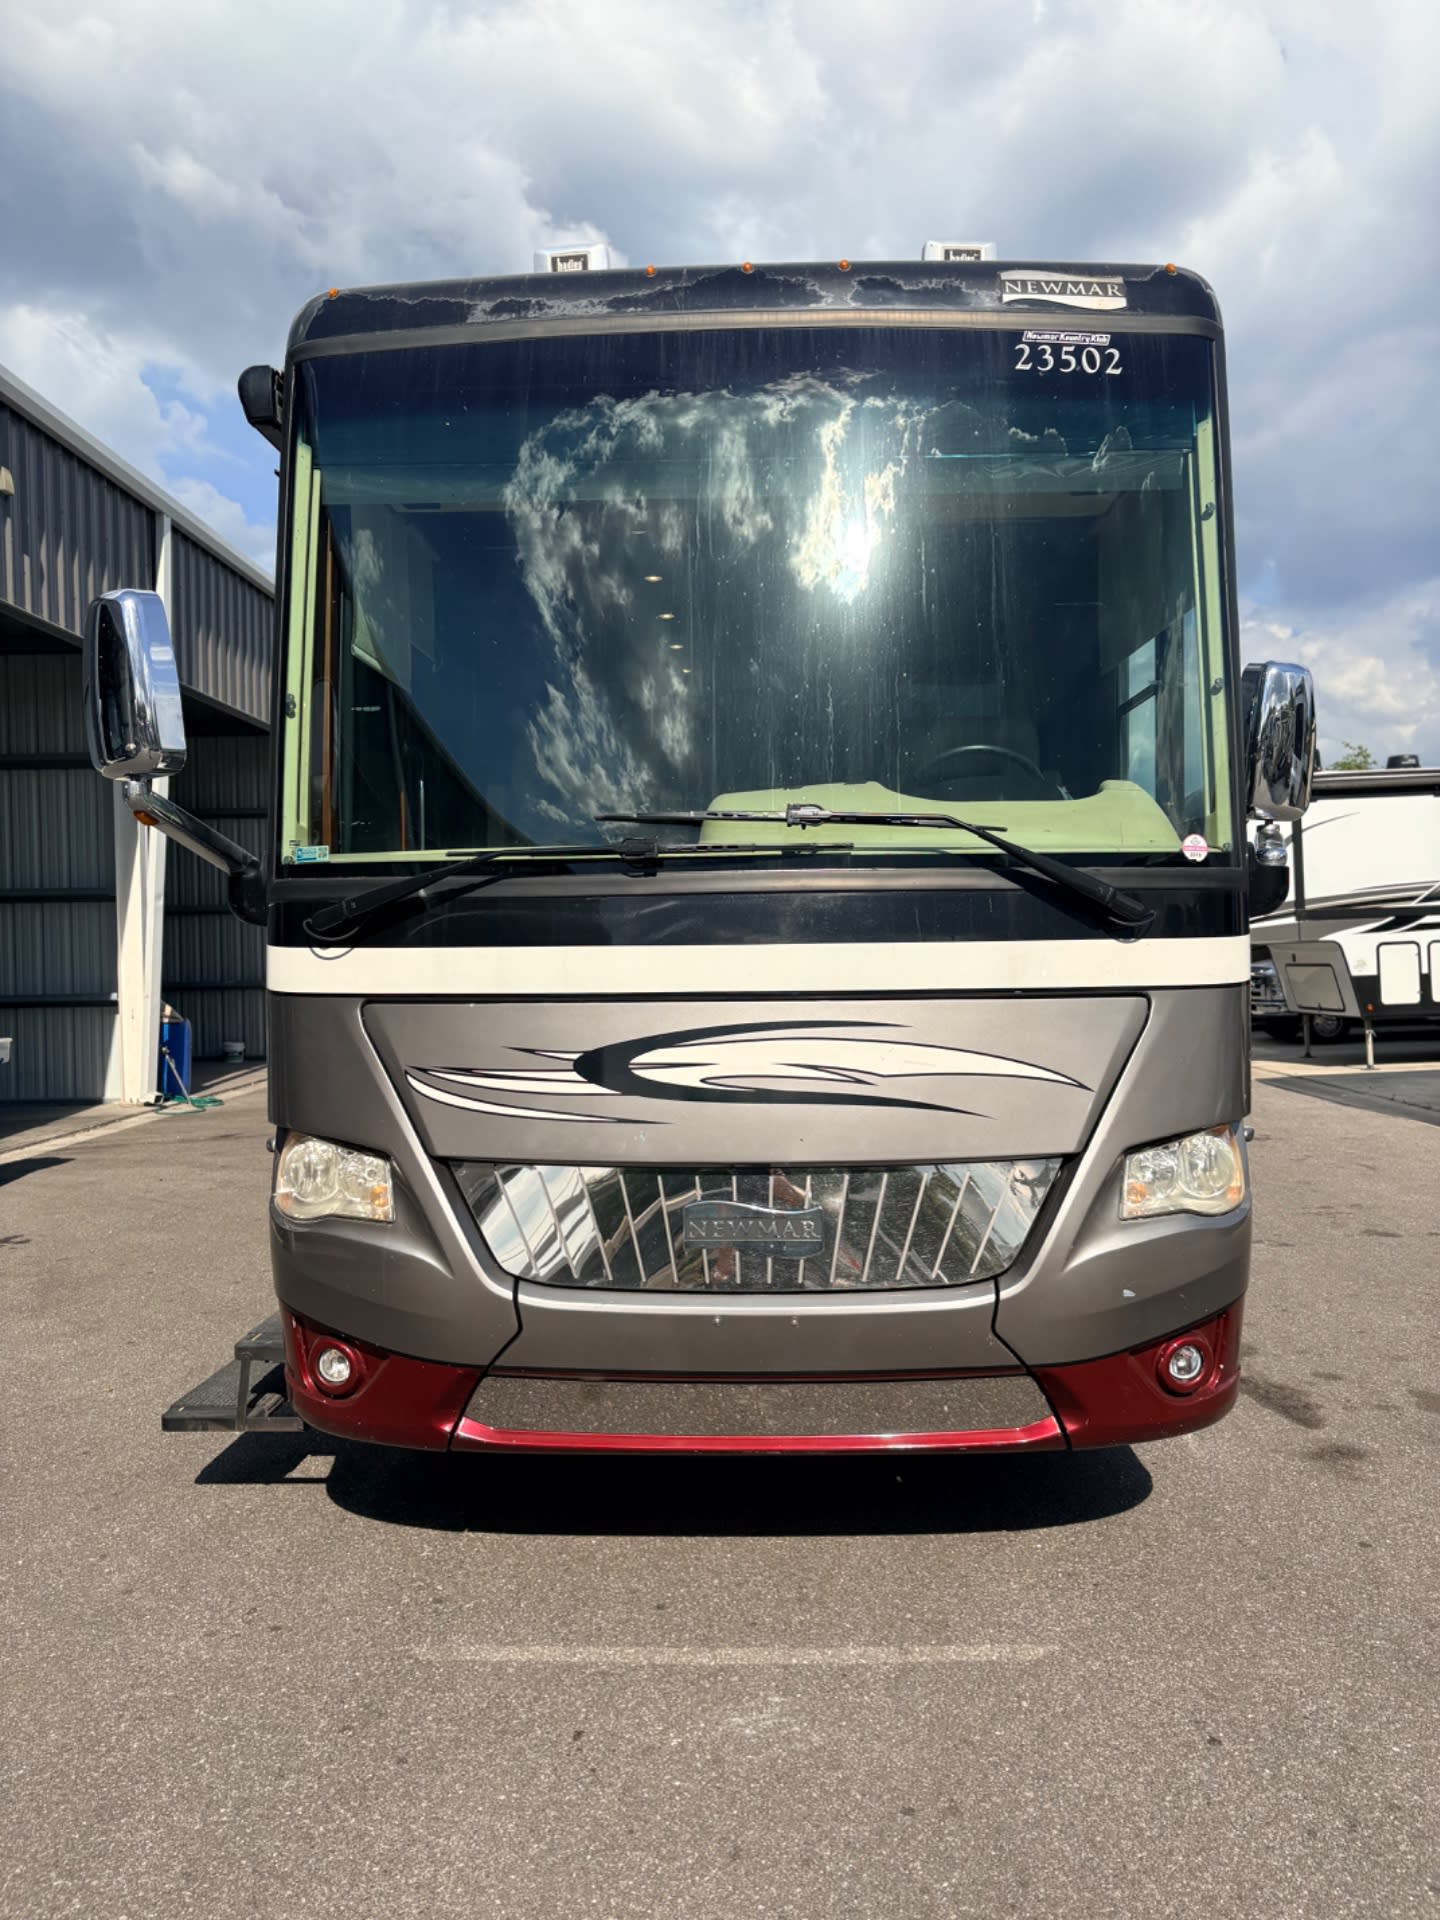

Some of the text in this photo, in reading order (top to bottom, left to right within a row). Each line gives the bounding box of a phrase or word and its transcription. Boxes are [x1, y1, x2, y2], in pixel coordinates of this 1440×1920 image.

[1004, 280, 1123, 297] NEWMAR
[1014, 343, 1123, 375] 23502
[688, 1220, 821, 1239] NEWMAR
